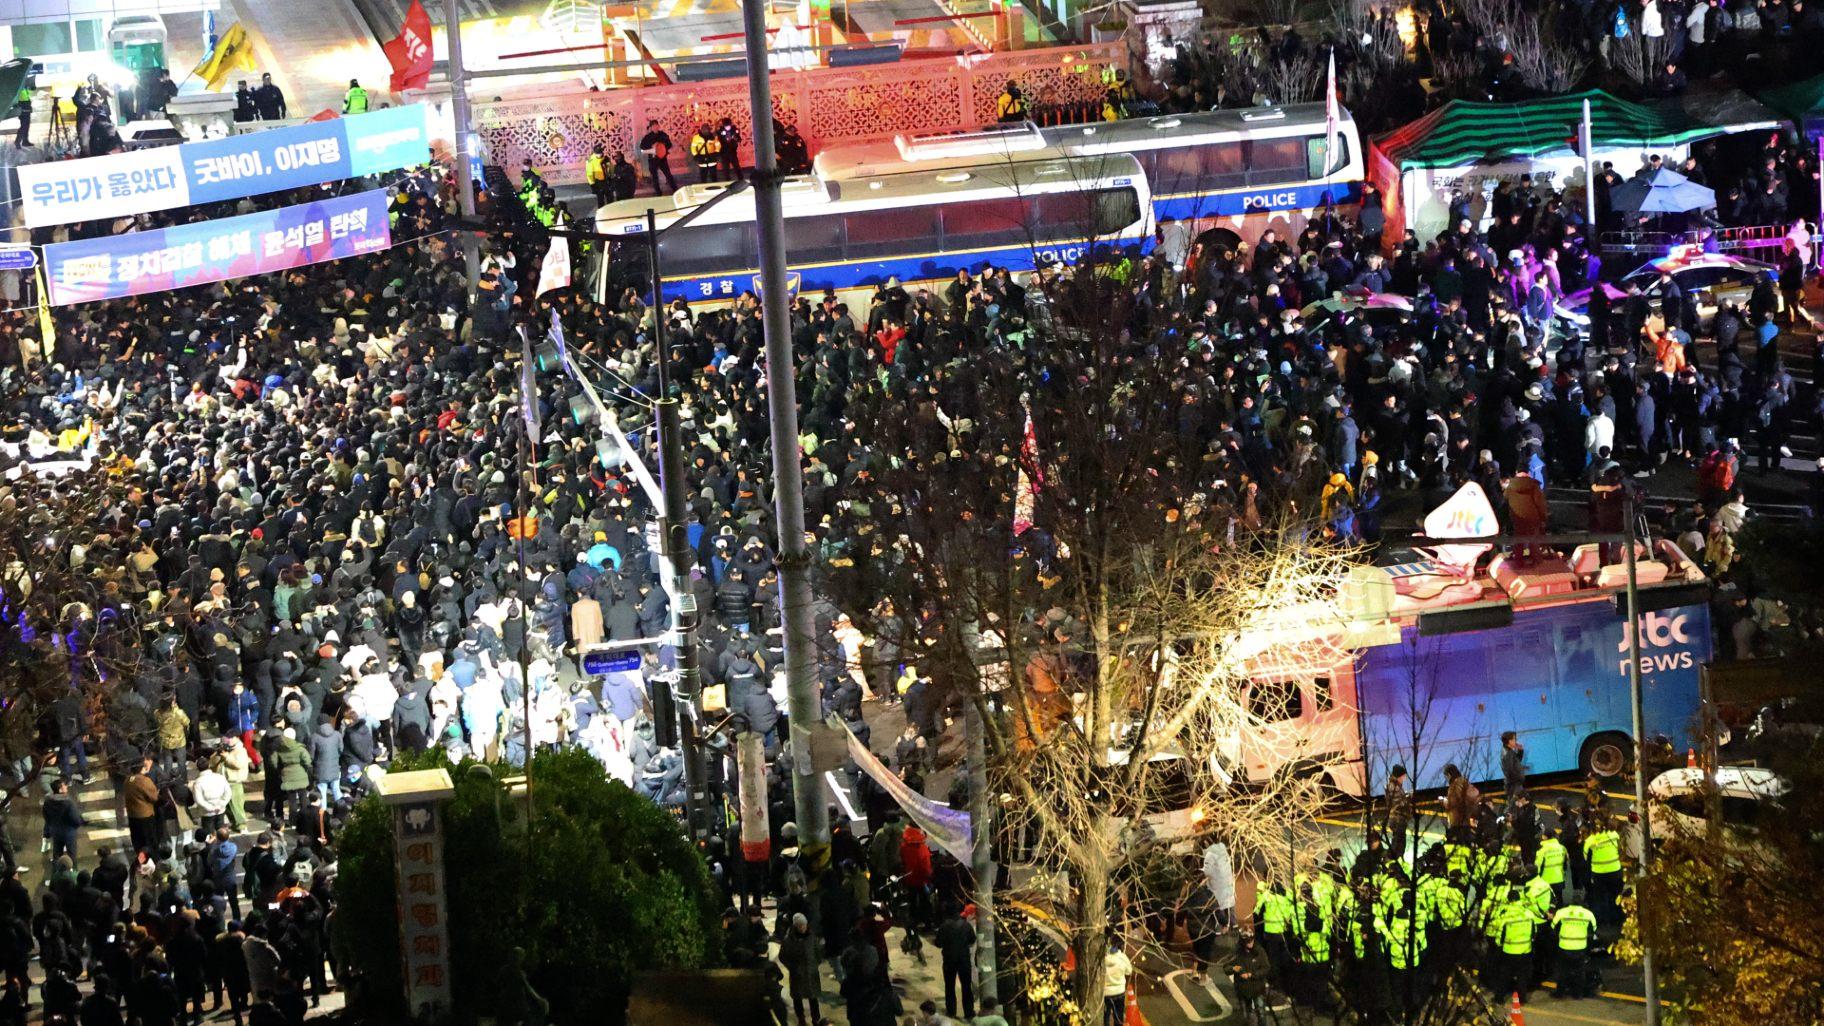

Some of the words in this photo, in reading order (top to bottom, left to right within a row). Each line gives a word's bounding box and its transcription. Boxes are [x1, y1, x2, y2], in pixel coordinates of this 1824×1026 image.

[31, 176, 102, 206] 우리가
[108, 165, 177, 198] 옳았다
[274, 137, 341, 171] 이재명
[1243, 192, 1297, 210] POLICE
[264, 218, 325, 257] 윤석열
[330, 207, 368, 240] 탄핵
[700, 280, 734, 297] 경찰
[1620, 651, 1693, 676] news
